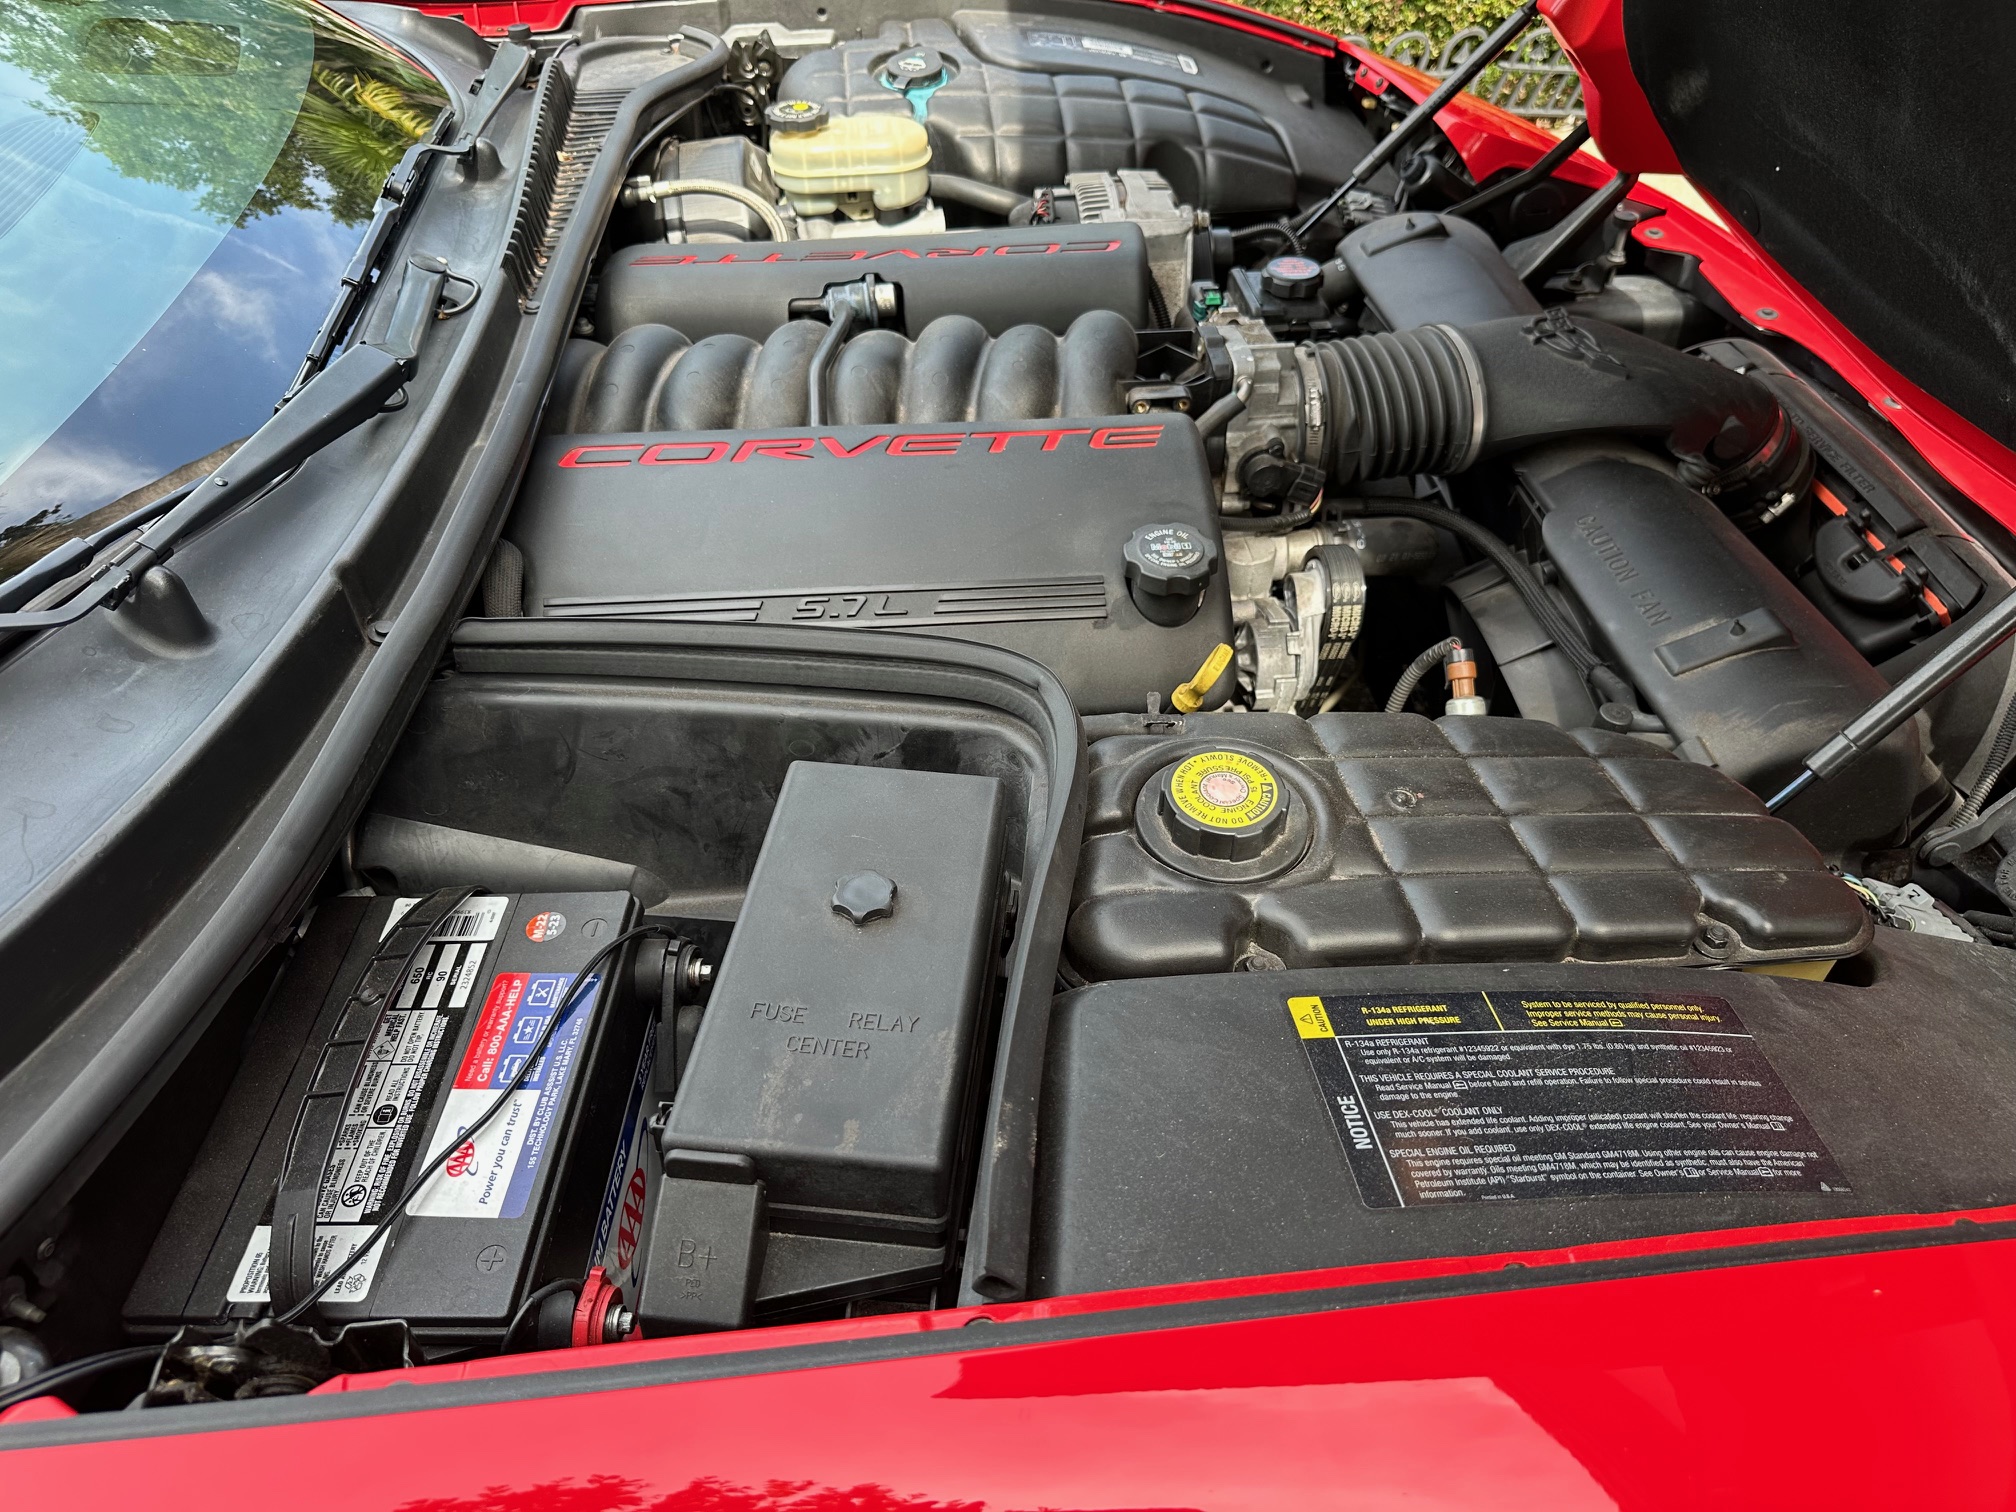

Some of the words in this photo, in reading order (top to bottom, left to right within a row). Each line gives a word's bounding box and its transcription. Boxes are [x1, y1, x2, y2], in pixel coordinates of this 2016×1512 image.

[630, 239, 1122, 267] CORVETTE
[557, 424, 1165, 469] CORVETTE
[1144, 529, 1174, 541] ENGINE
[1176, 530, 1190, 540] OIL
[1576, 513, 1639, 583] CAUTION
[1630, 588, 1672, 627] FAN
[792, 595, 908, 620] 5.7L
[1200, 753, 1235, 764] SLOWLY
[1238, 756, 1268, 778] REMOVE
[1179, 763, 1195, 775] HOT
[1196, 764, 1242, 778] PRESSURE
[1242, 773, 1254, 784] PSI
[1175, 774, 1184, 794] WHEN
[1191, 780, 1216, 811] COOLANT
[1178, 795, 1208, 820] REMOVE
[1220, 800, 1254, 814] ENGINE
[1246, 791, 1273, 821] CAUTION
[1209, 816, 1228, 825] NOT
[1231, 816, 1244, 825] DO
[532, 913, 549, 938] M-22
[547, 914, 561, 936] 5-23
[410, 967, 424, 984] 650
[435, 970, 447, 981] 90
[450, 965, 461, 985] SERIAL
[459, 960, 476, 989] 2324852
[1361, 1006, 1391, 1014] R-134a
[1392, 1004, 1447, 1013] REFRIGERANT
[1521, 1001, 1550, 1010] System
[1606, 1001, 1617, 1010] by
[1618, 1001, 1650, 1011] qualified
[1651, 1003, 1686, 1012] personnel
[1687, 1004, 1704, 1013] only.
[1526, 1010, 1562, 1019] Improper
[1593, 1010, 1626, 1019] methods
[1627, 1012, 1644, 1020] may
[1668, 1012, 1699, 1021] personal
[1700, 1013, 1722, 1023] injury.
[384, 1013, 399, 1036] MEDICAL
[390, 1028, 400, 1041] HELP
[395, 1013, 406, 1027] FAST.
[571, 1017, 583, 1035] 32746
[750, 1002, 808, 1025] FUSE
[848, 1012, 920, 1033] RELAY
[1310, 1004, 1328, 1032] CAUTION
[1417, 1016, 1460, 1024] PRESSURE
[1532, 1019, 1542, 1027] See
[1544, 1019, 1578, 1027] Service
[1580, 1019, 1609, 1027] Manual
[464, 1068, 475, 1081] Need
[473, 1038, 487, 1058] battery
[486, 1005, 500, 1029] warranty
[495, 979, 507, 1004] support?
[477, 1057, 493, 1081] Call:
[487, 979, 521, 1054] 800-AAA-HELP
[568, 1036, 577, 1044] FL
[403, 1045, 411, 1054] NOT
[407, 1032, 416, 1044] OPEN
[410, 1044, 418, 1053] NOT
[786, 1036, 871, 1059] CENTER
[1375, 1037, 1428, 1046] REFRIGERANT
[561, 1045, 574, 1065] MARY,
[555, 1066, 566, 1084] LAKE
[1358, 1074, 1378, 1082] THIS
[1378, 1073, 1412, 1081] VEHICLE
[1413, 1071, 1454, 1080] REQUIRES
[1461, 1070, 1495, 1078] SPECIAL
[1496, 1068, 1533, 1077] COOLANT
[1534, 1068, 1568, 1076] SERVICE
[1568, 1067, 1615, 1075] PROCEDURE
[353, 1103, 361, 1112] CAN
[357, 1088, 368, 1102] CAUSE
[363, 1061, 378, 1086] BLINDNESS
[363, 1088, 375, 1104] SEVERE
[385, 1089, 394, 1101] READ
[390, 1079, 399, 1087] ALL
[526, 1128, 537, 1145] DIST.
[532, 1116, 541, 1126] BY
[537, 1096, 548, 1115] CLUB
[553, 1054, 562, 1066] U.S.
[558, 1038, 568, 1053] LLC.
[547, 1085, 561, 1105] PARK,
[1379, 1093, 1409, 1101] damage
[360, 1105, 367, 1113] OR
[1373, 1110, 1391, 1119] USE
[1440, 1106, 1479, 1116] COOLANT
[1481, 1106, 1502, 1114] ONLY
[531, 1106, 552, 1154] TECHNOLOGY
[1337, 1096, 1372, 1149] NOTICE
[354, 1169, 363, 1182] KEEP
[359, 1158, 367, 1168] OUT
[366, 1139, 375, 1149] THE
[446, 1141, 476, 1178] AAA
[1389, 1148, 1425, 1157] SPECIAL
[1425, 1146, 1457, 1156] ENGINE
[1458, 1145, 1473, 1154] OIL
[1474, 1144, 1515, 1153] REQUIRED
[478, 1170, 497, 1204] Power
[493, 1148, 505, 1168] you
[501, 1128, 512, 1146] can
[527, 1156, 536, 1168] 155
[361, 1165, 371, 1182] REACH
[316, 1207, 326, 1218] CAN
[321, 1189, 333, 1206] CAUSE
[329, 1159, 345, 1187] BLINDNESS
[600, 1139, 626, 1241] BATTERY
[323, 1210, 331, 1218] OR
[618, 1167, 646, 1270] AAA
[677, 1238, 718, 1271] B+
[240, 1258, 259, 1293] PROPOSITION
